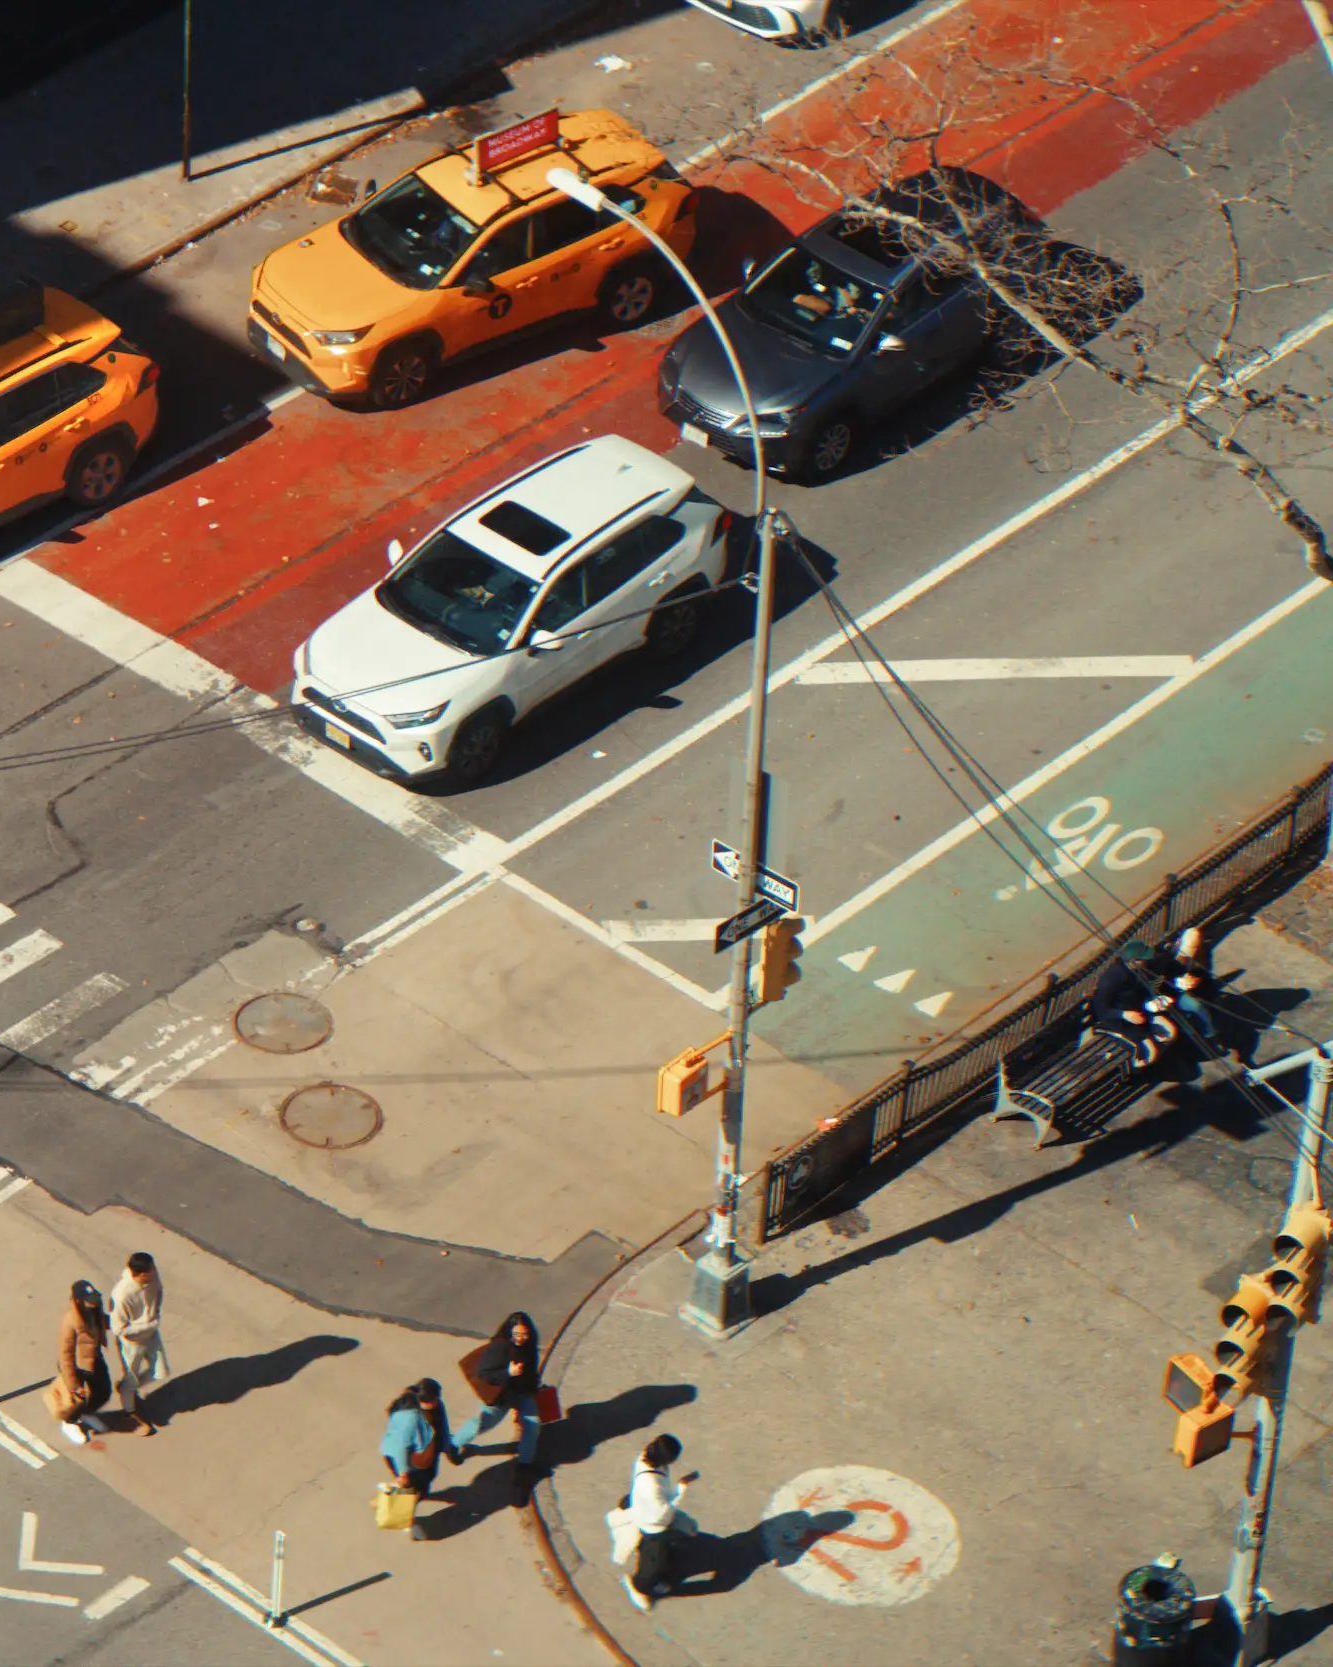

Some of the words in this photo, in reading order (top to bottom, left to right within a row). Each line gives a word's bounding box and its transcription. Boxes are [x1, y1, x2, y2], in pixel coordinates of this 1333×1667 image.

[487, 124, 530, 147] MUSEUM
[488, 127, 546, 158] BROADWAY
[764, 878, 790, 899] WAY
[727, 916, 749, 938] ONE
